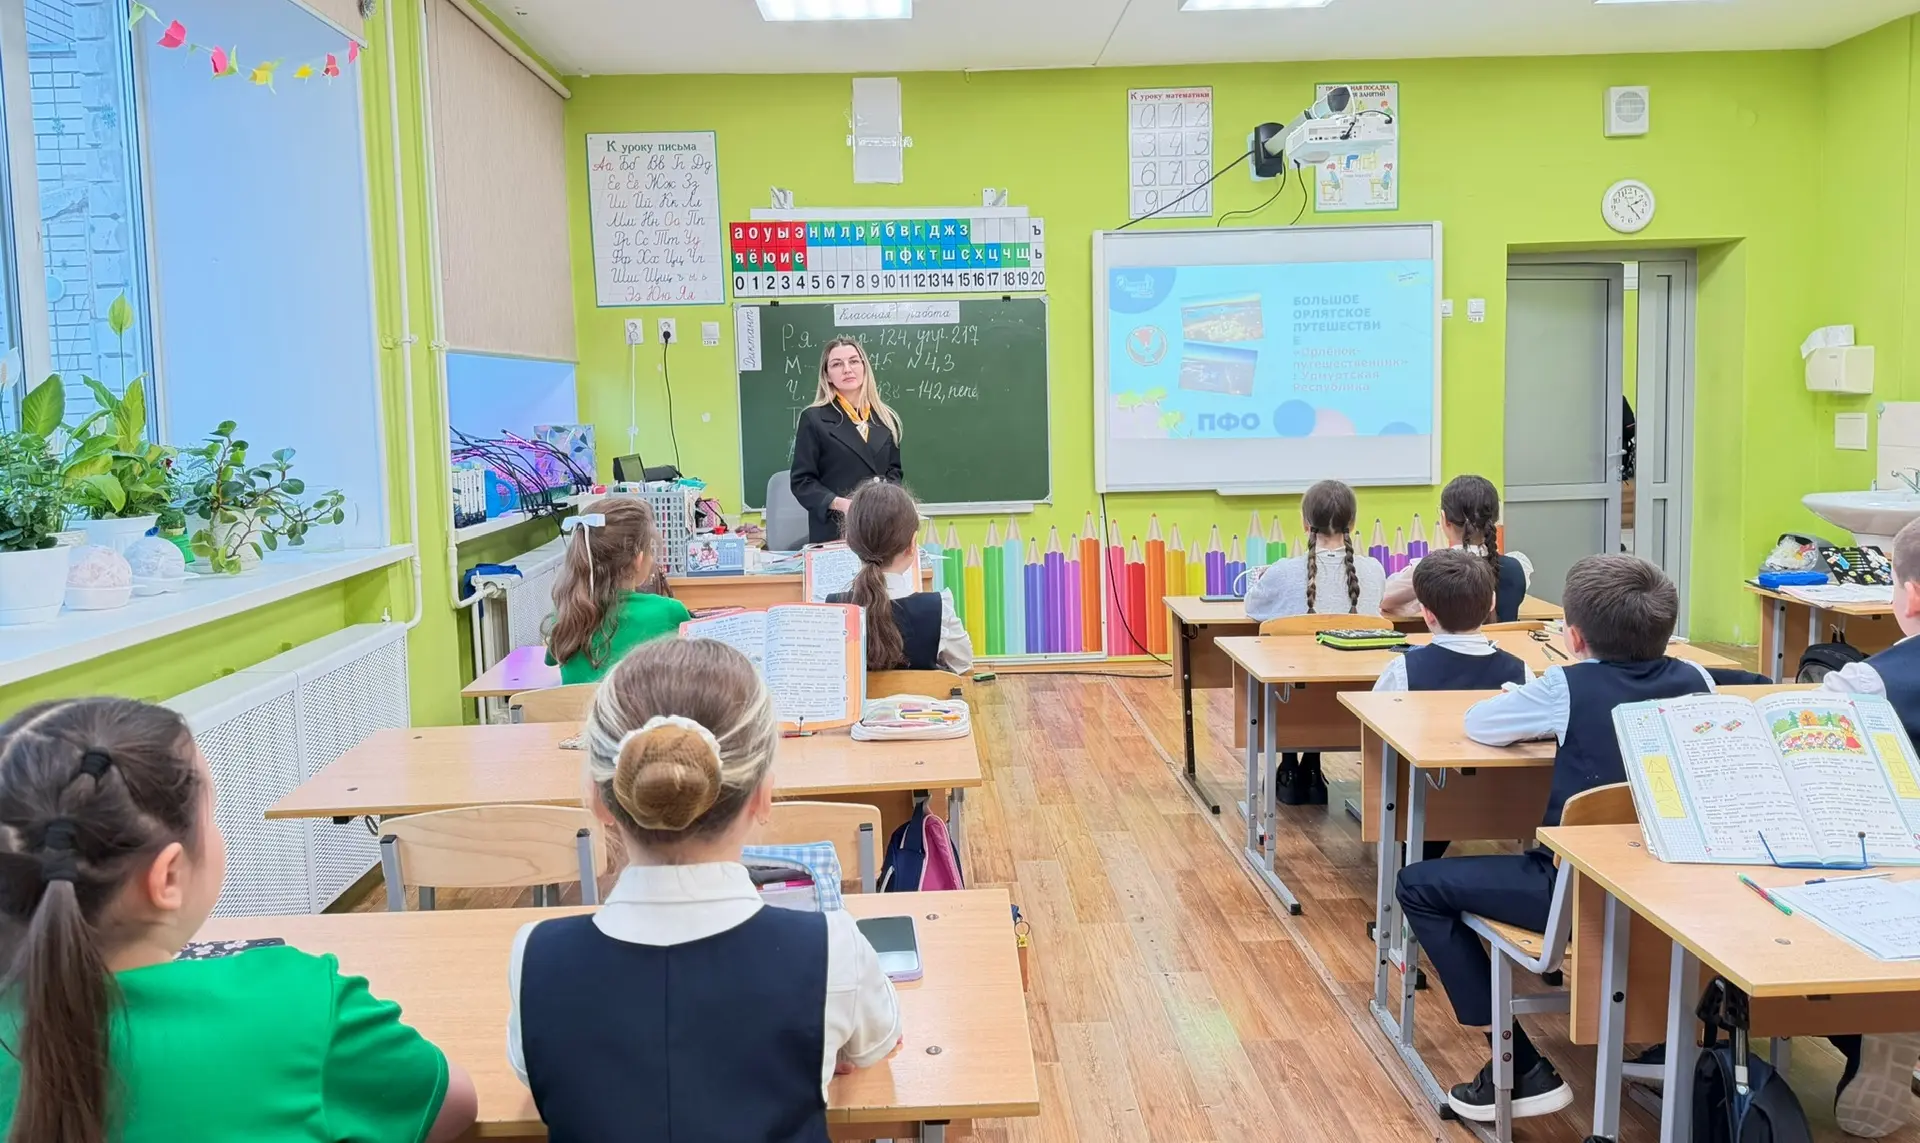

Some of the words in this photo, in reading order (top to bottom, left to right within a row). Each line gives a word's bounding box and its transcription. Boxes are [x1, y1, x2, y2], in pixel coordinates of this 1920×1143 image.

[1140, 93, 1162, 101] уроку
[606, 141, 616, 151] К
[622, 143, 653, 154] уроку
[659, 143, 696, 151] письма
[734, 227, 743, 239] а
[749, 227, 758, 239] о
[763, 228, 772, 242] у
[777, 228, 789, 238] ы
[795, 227, 804, 238] э
[809, 227, 818, 238] н
[824, 227, 835, 237] м
[841, 227, 850, 237] л
[856, 226, 864, 240] р
[871, 223, 879, 237] й
[886, 222, 894, 237] б
[901, 226, 908, 236] в
[915, 226, 921, 236] г
[929, 225, 940, 238] д
[944, 225, 955, 235] ж
[960, 225, 968, 235] з
[735, 252, 743, 263] я
[749, 249, 757, 263] ё
[764, 252, 776, 263] ю
[780, 253, 789, 263] и
[795, 252, 804, 263] е
[885, 250, 893, 261] п
[900, 247, 911, 264] ф
[917, 250, 924, 260] к
[930, 250, 937, 260] т
[943, 250, 955, 260] ш
[962, 250, 969, 260] с
[975, 249, 983, 259] х
[989, 249, 998, 262] ц
[1003, 248, 1010, 259] ч
[1016, 248, 1029, 260] щ
[735, 276, 744, 290] 0
[753, 276, 758, 289] 1
[766, 276, 775, 289] 2
[782, 276, 790, 289] 3
[796, 275, 805, 289] 4
[812, 275, 820, 289] 5
[827, 275, 835, 288] 6
[841, 275, 850, 288] 7
[856, 275, 865, 288] 8
[871, 274, 879, 288] 9
[884, 274, 895, 288] 10
[900, 274, 909, 287] 11
[914, 274, 925, 287] 12
[928, 273, 940, 287] 13
[942, 273, 954, 286] 14
[958, 273, 970, 286] 15
[973, 273, 984, 286] 16
[987, 272, 999, 286] 17
[1003, 272, 1015, 285] 18
[1017, 271, 1029, 285] 19
[1032, 271, 1044, 285] 20
[1293, 295, 1360, 306] БОЛЬШОЕ
[839, 305, 892, 321] Классная
[906, 306, 951, 322] работа
[1293, 308, 1371, 319] ОРЛЯТСКОЕ
[1293, 321, 1381, 332] ПУТЕШЕСТВИ
[743, 309, 756, 368] Диктант
[1293, 336, 1301, 345] Е
[1198, 412, 1260, 431] ПФО
